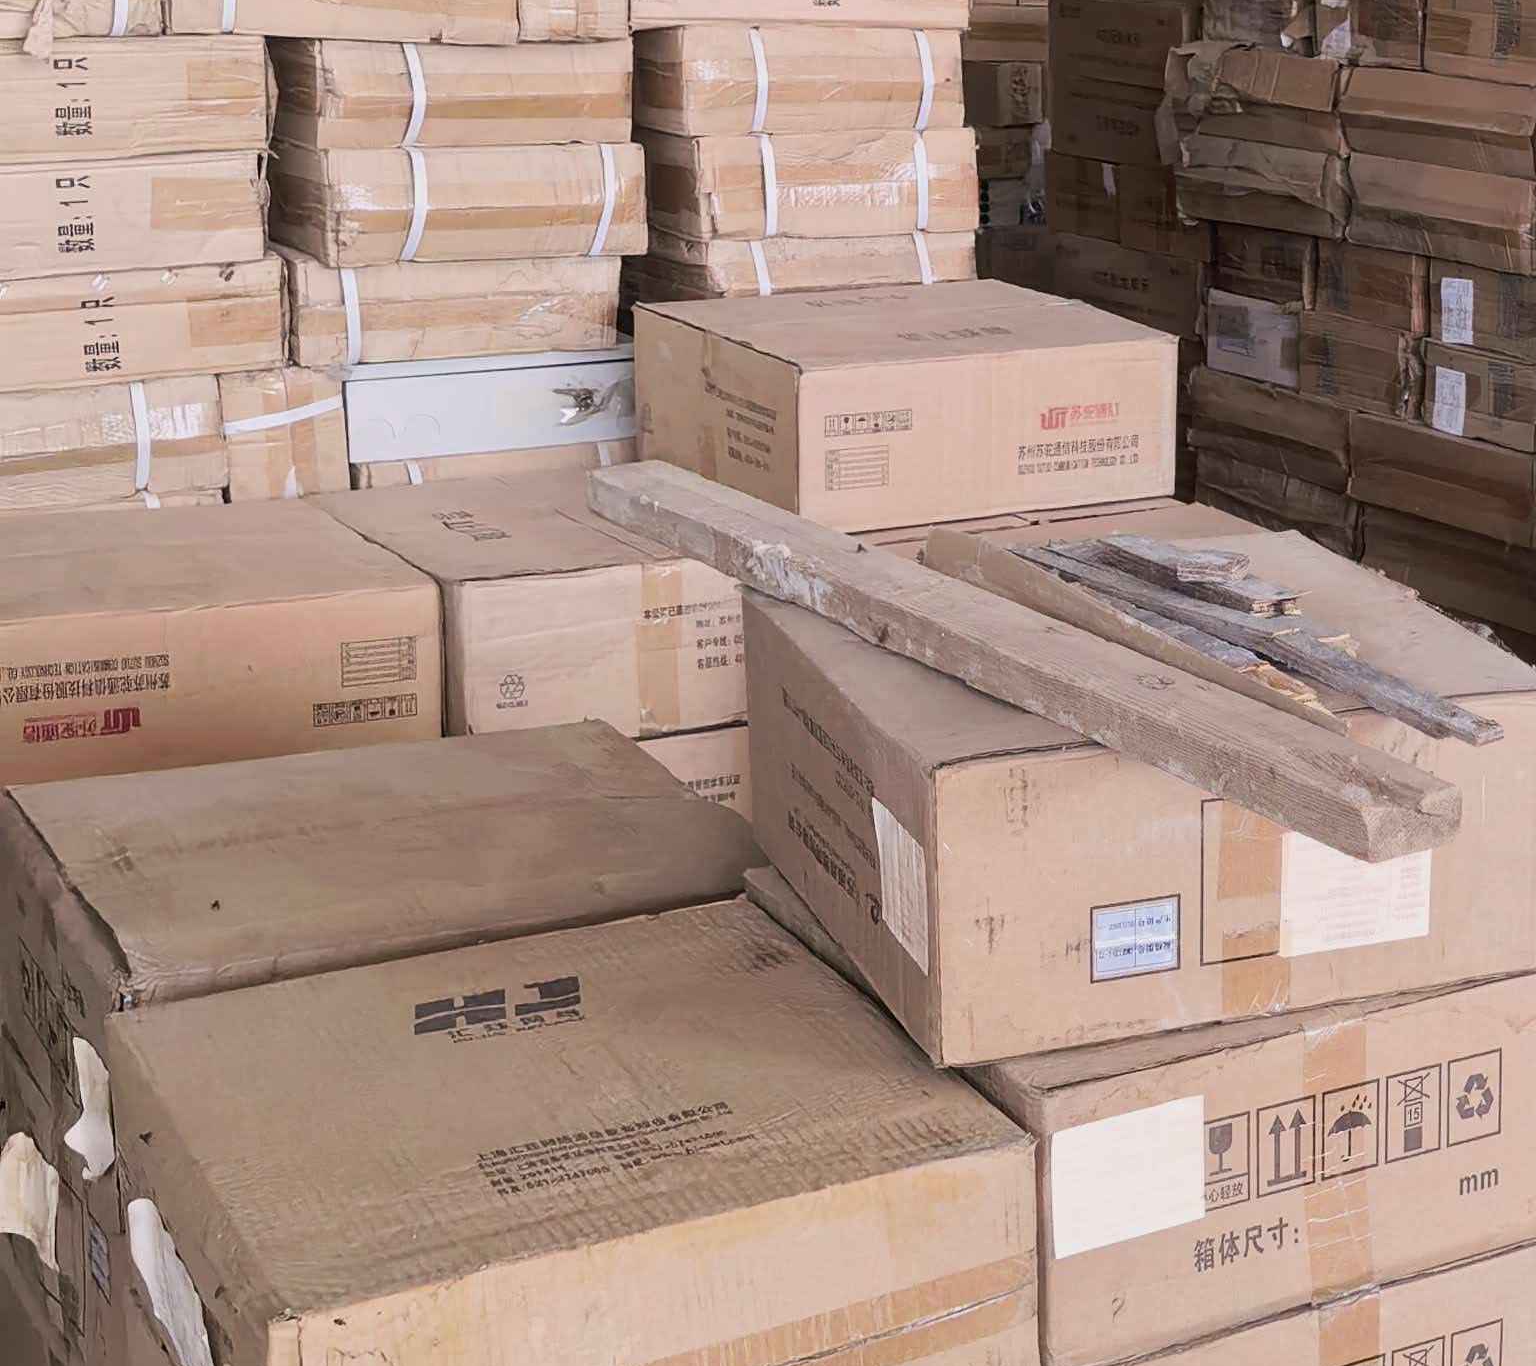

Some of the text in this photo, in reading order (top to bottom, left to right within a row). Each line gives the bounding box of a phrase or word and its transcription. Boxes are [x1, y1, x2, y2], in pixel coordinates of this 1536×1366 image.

[0, 672, 170, 703] 苏州苏驼通信科技股份有限公
[1459, 1167, 1499, 1196] mm
[1193, 1216, 1300, 1273] 箱体尺寸:
